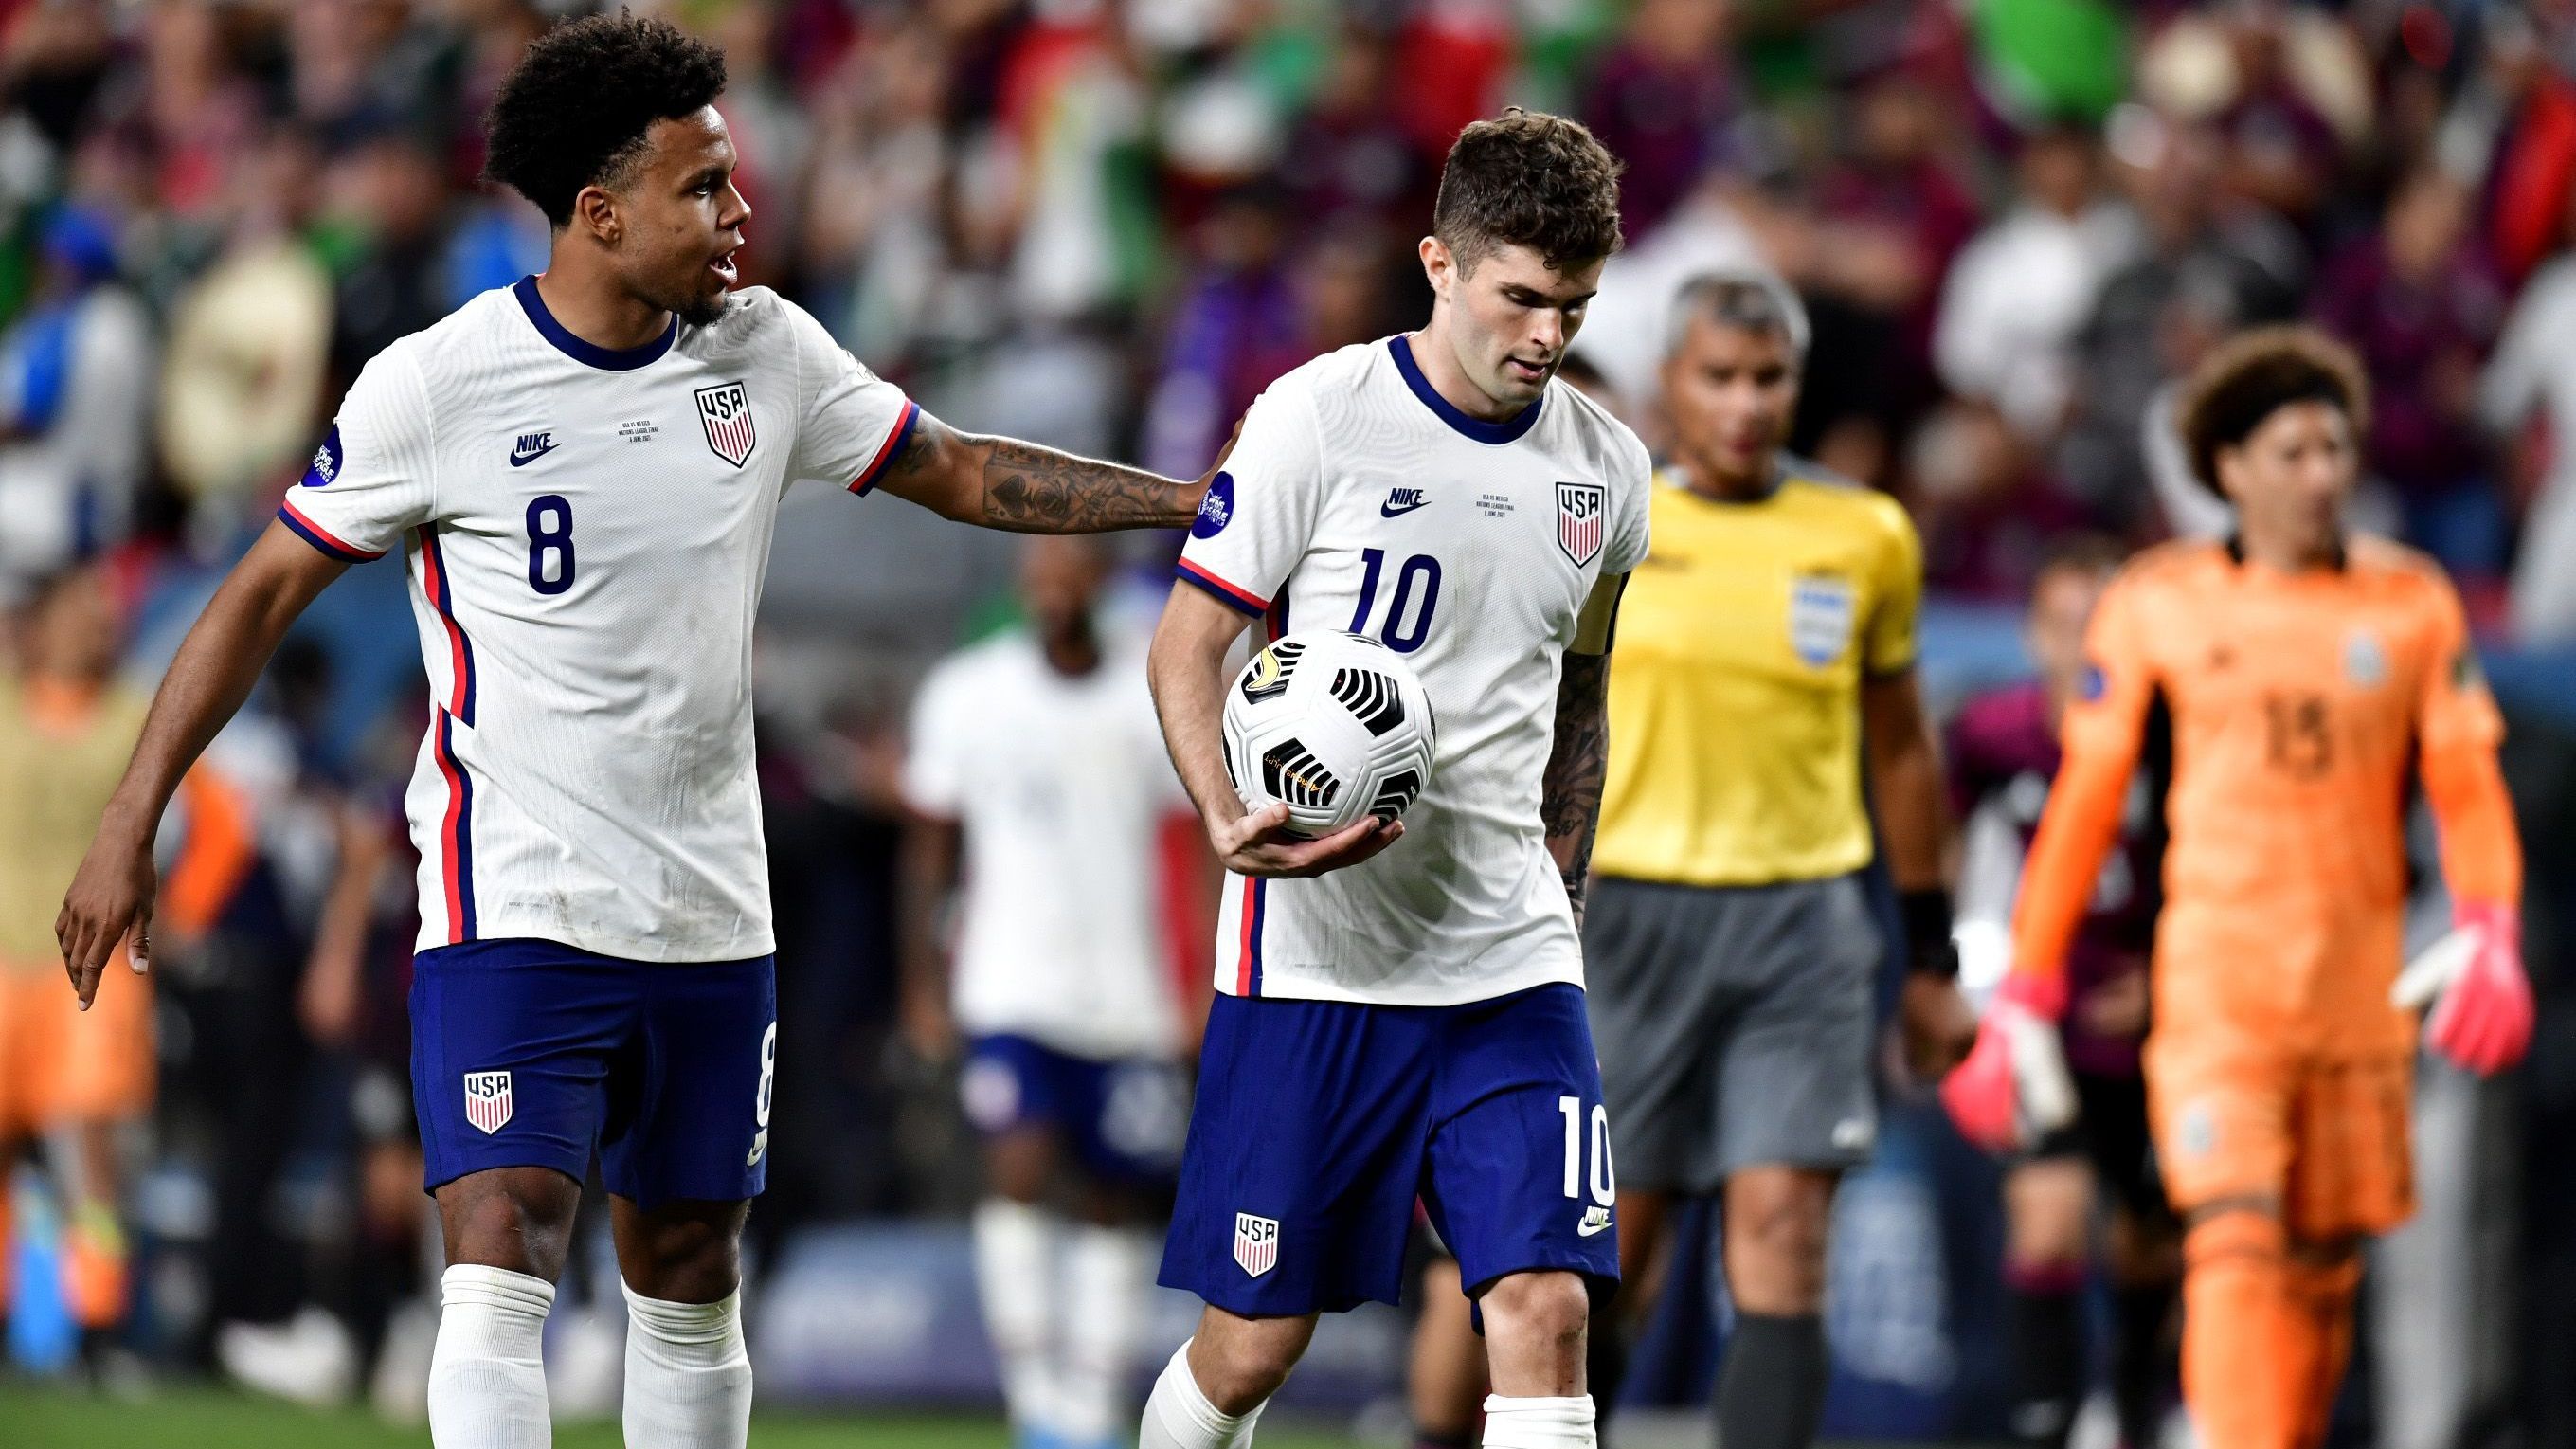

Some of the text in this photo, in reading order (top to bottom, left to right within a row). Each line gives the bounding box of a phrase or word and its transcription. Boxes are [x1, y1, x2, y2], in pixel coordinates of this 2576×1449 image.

[701, 389, 744, 420] USA
[515, 432, 551, 453] NIKE
[1388, 487, 1424, 506] NIKE
[1560, 488, 1599, 519] USA
[525, 494, 575, 595] 8
[1348, 547, 1442, 653] 10
[468, 1075, 509, 1098] USA
[756, 1021, 777, 1128] 8
[1558, 1096, 1615, 1207] 10
[1239, 1217, 1276, 1242] USA
[1584, 1205, 1610, 1225] NIKE
